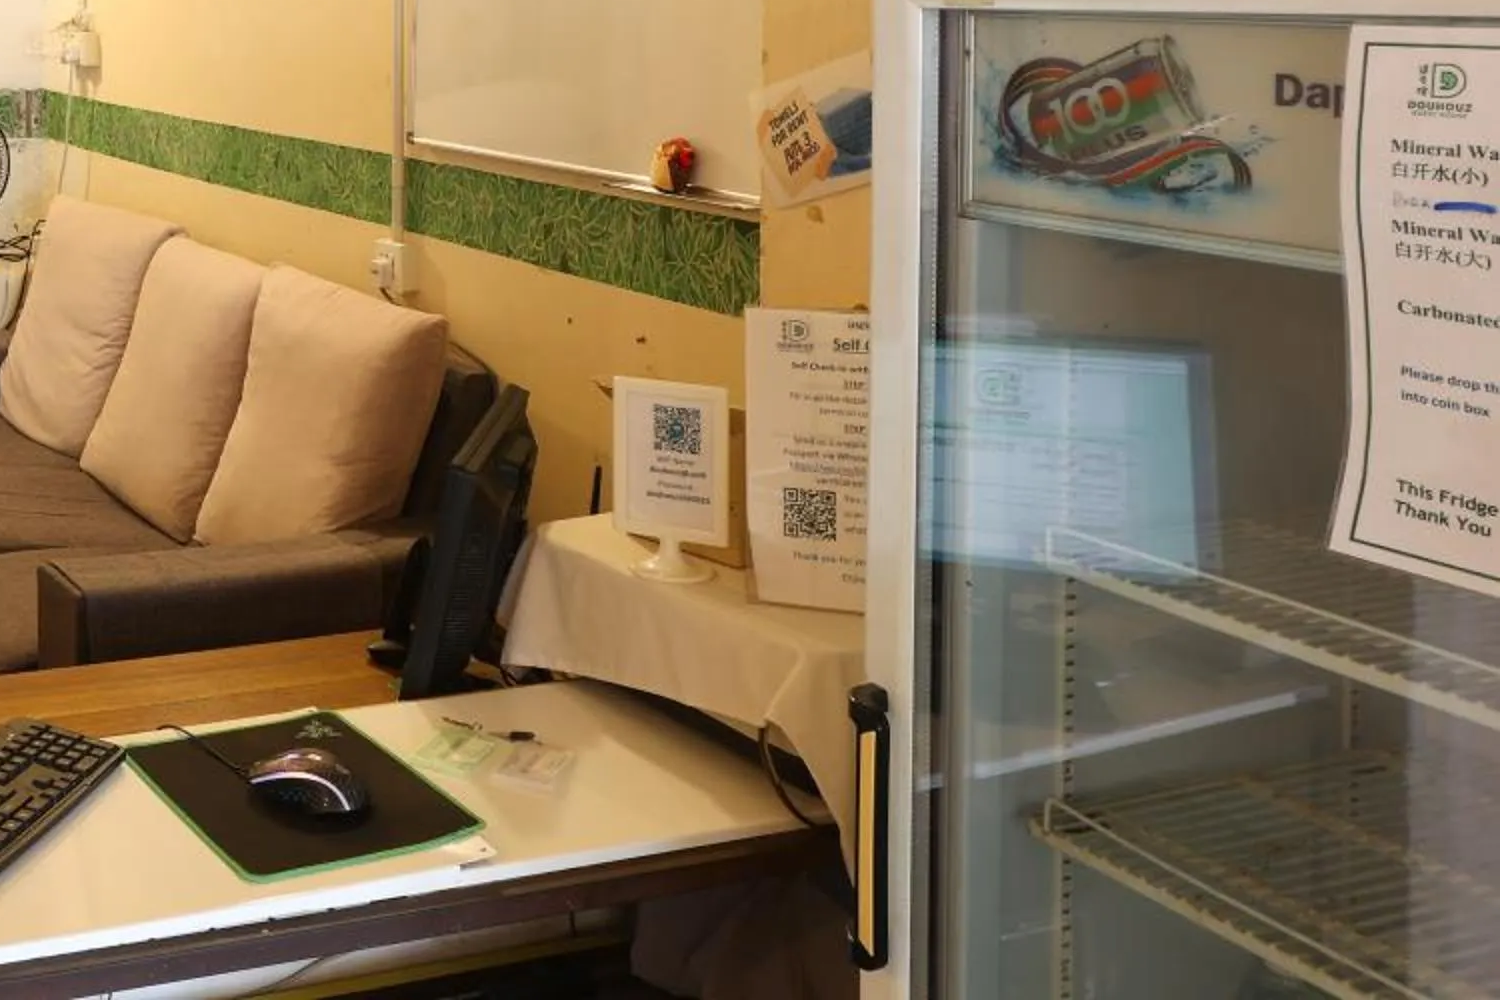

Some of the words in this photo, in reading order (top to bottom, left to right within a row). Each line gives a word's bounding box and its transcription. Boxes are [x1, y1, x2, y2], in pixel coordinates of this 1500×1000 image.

[1407, 100, 1473, 112] DOUHOUZ
[1391, 138, 1461, 159] Mineral
[1391, 219, 1463, 241] Mineral
[1401, 365, 1443, 383] Please
[1447, 376, 1481, 393] drop
[1484, 381, 1500, 395] th
[1401, 390, 1429, 405] into
[1431, 397, 1460, 412] coin
[1463, 403, 1490, 418] box
[1396, 478, 1434, 501] This
[1438, 489, 1499, 517] Fridge
[1393, 499, 1450, 528] Thank
[1456, 516, 1492, 537] You
